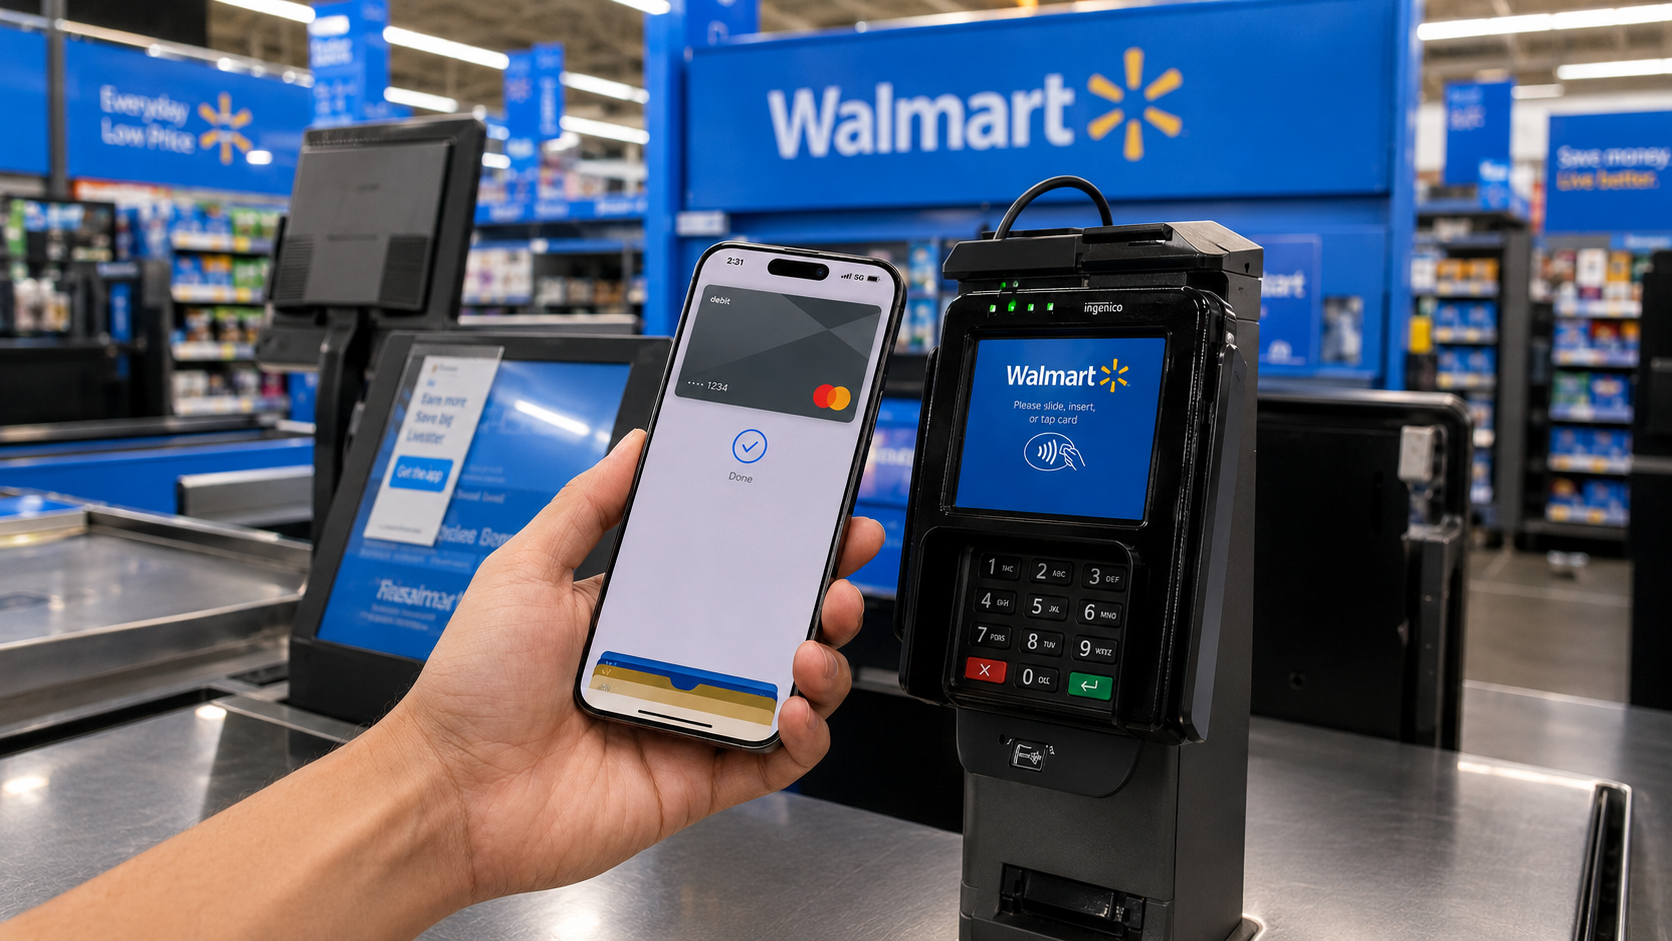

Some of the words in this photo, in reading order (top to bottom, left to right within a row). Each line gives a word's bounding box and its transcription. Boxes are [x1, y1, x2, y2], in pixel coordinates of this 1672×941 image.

[100, 84, 190, 128] Everyday
[767, 73, 1076, 160] Walmart
[101, 116, 146, 148] Low
[146, 123, 196, 154] Price
[1556, 145, 1602, 169] Save
[1557, 169, 1595, 191] Live
[1596, 168, 1660, 191] better.
[727, 257, 744, 266] 2:31
[710, 296, 731, 305] debit
[1084, 302, 1123, 315] ingenico
[1007, 365, 1096, 386] Walmart
[707, 381, 728, 391] 1234
[1014, 400, 1041, 410] Please
[1043, 401, 1066, 411] slide,
[1068, 402, 1096, 412] insert,
[1029, 415, 1039, 423] or
[1041, 415, 1055, 425] tap
[1057, 415, 1078, 424] card
[729, 471, 753, 483] Done
[988, 558, 996, 575] 1
[1036, 563, 1047, 580] 2
[1052, 570, 1066, 578] ABC
[1089, 568, 1100, 585] 3
[1105, 575, 1120, 583] DEF
[981, 592, 991, 608] 4
[1031, 598, 1043, 614] 5
[1084, 603, 1095, 620] 6
[1100, 611, 1117, 620] MNO
[977, 626, 987, 643] 7
[1027, 633, 1038, 650] 8
[1043, 640, 1056, 648] TUV
[1079, 640, 1091, 657] 9
[1022, 668, 1033, 685] 0
